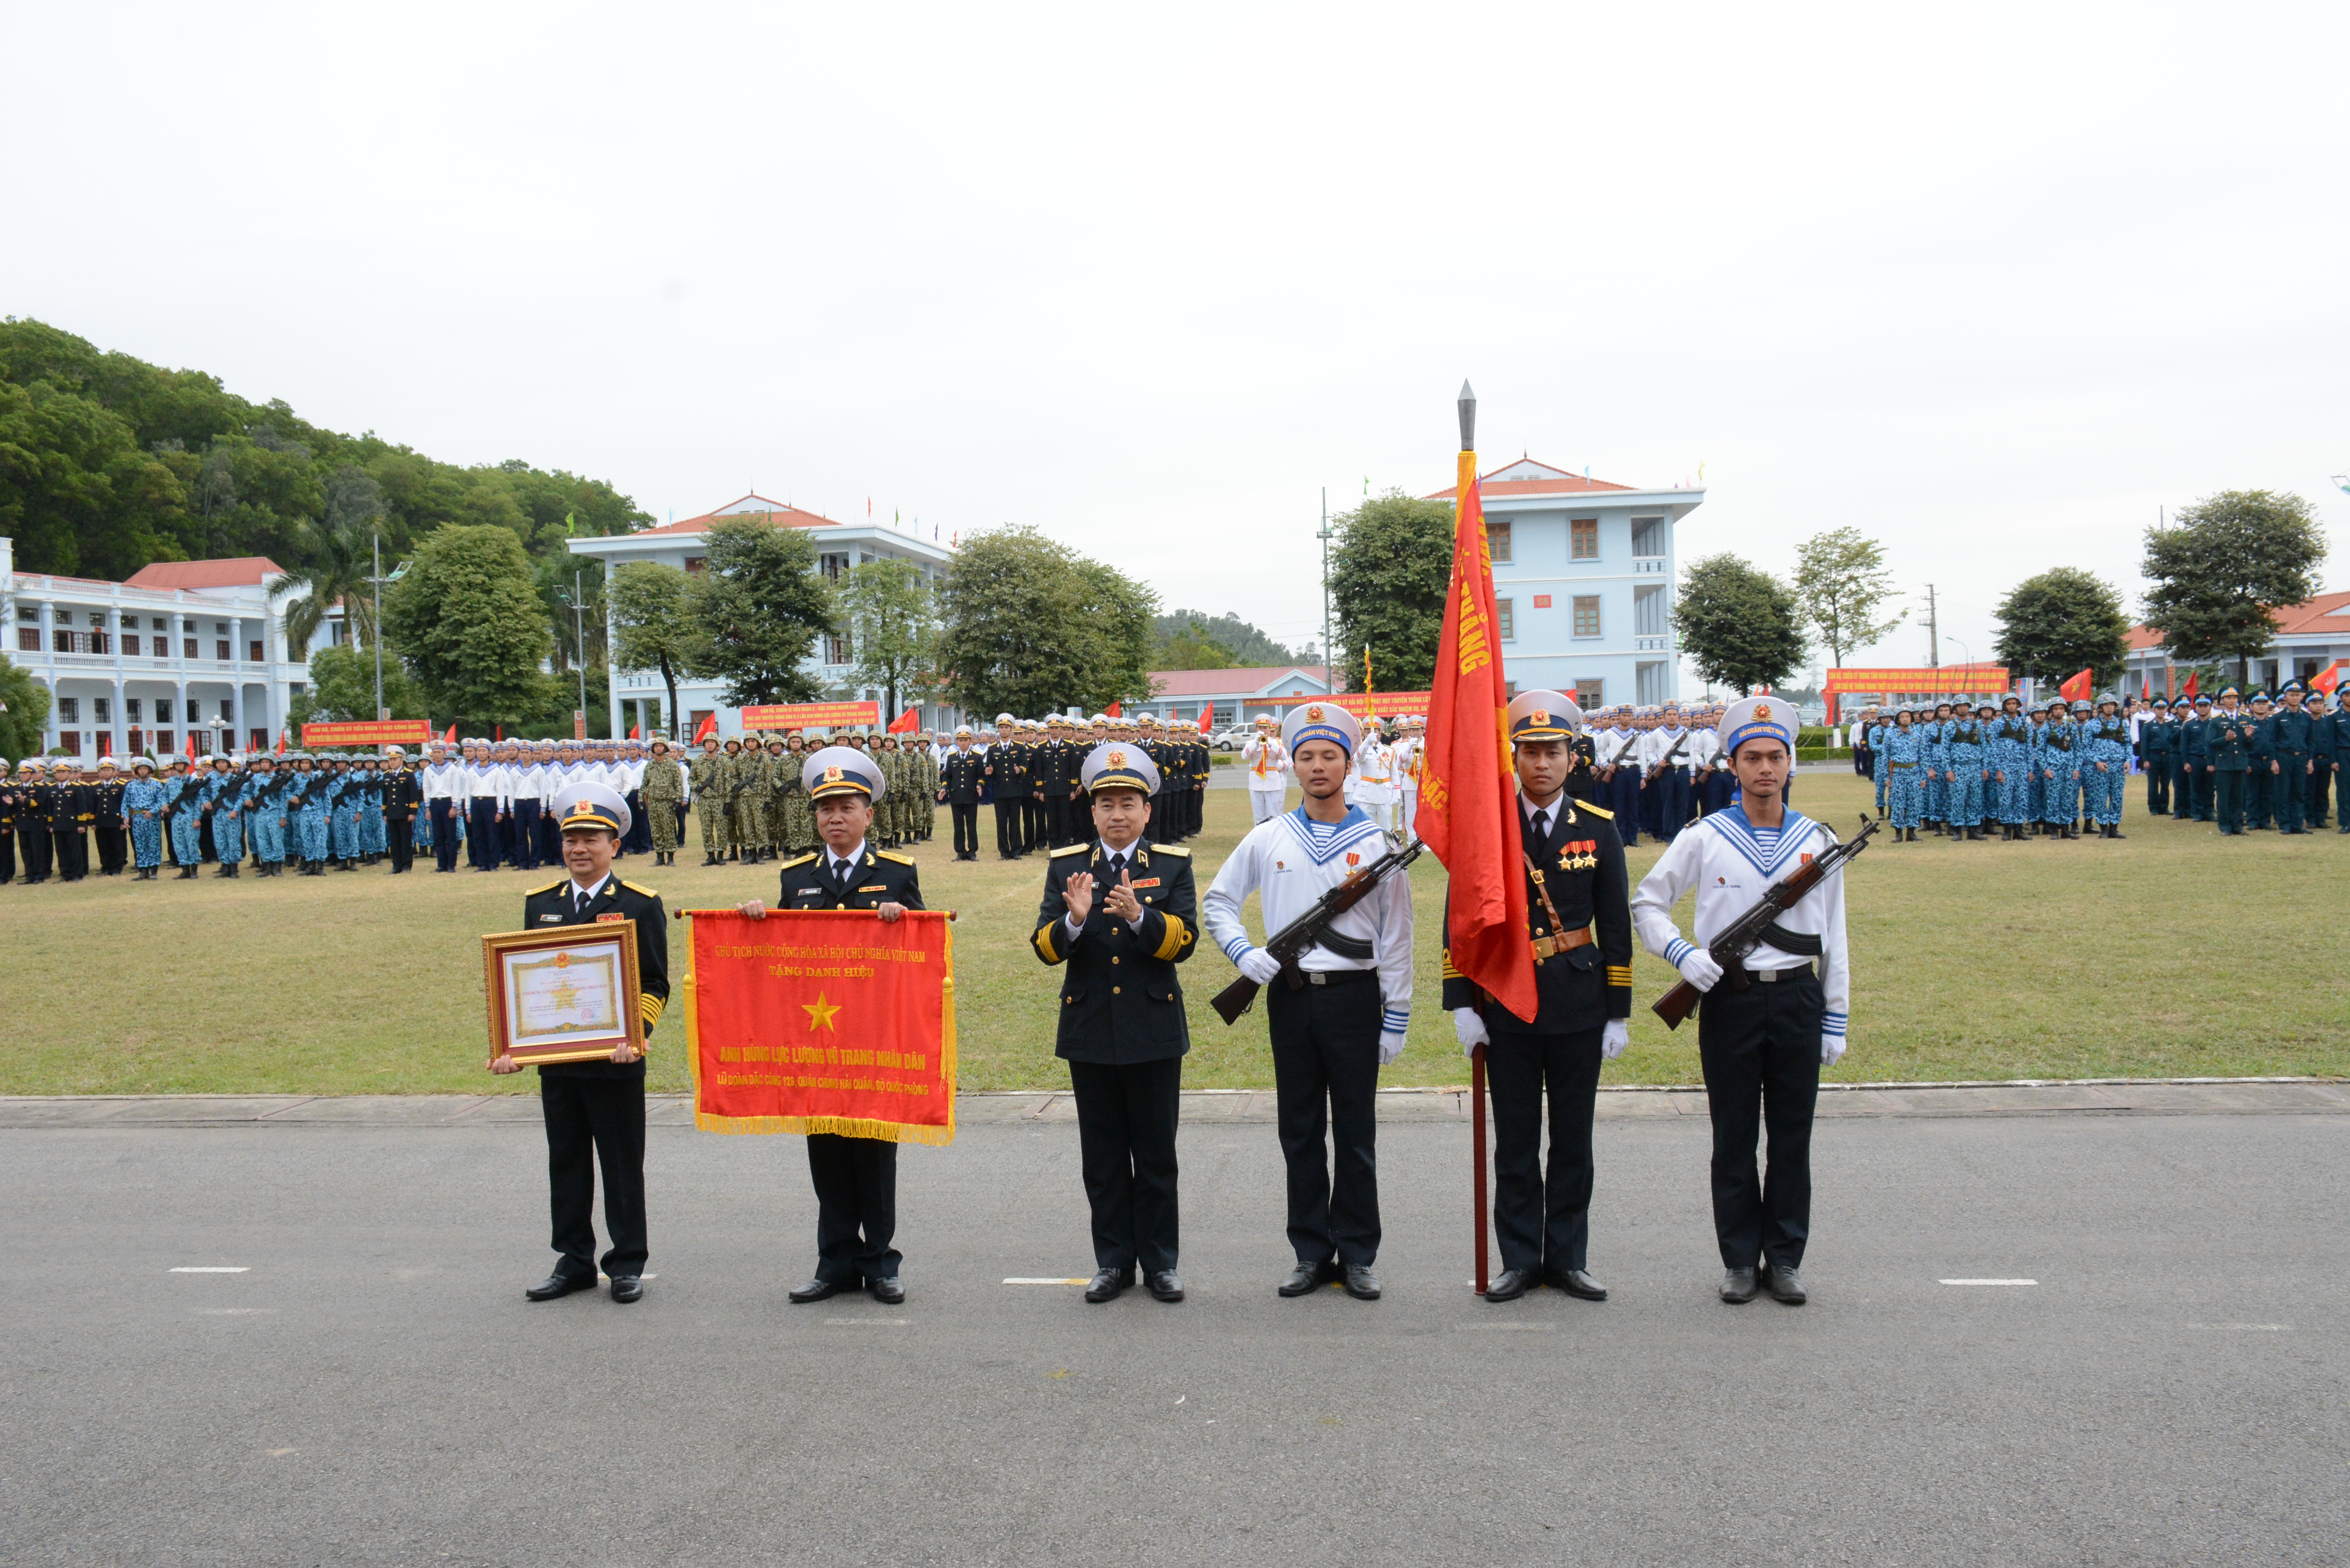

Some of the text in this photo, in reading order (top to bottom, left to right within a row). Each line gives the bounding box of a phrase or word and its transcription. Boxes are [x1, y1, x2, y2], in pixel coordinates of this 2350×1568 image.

[1537, 597, 1549, 606] S8
[1302, 729, 1316, 738] QUÂN
[1316, 728, 1329, 736] VIỆT
[1329, 731, 1340, 740] NAM
[1747, 725, 1762, 734] QUÂN
[1762, 725, 1775, 734] VIỆT
[1775, 729, 1785, 737] NAM
[1422, 770, 1448, 810] ĐẶC
[715, 942, 926, 964] CHỦ TỊCH NƯỚC CỘNG HÒA XÃ HỘI CHỦ NGHĨA VIỆT NAM
[768, 964, 875, 979] TẶNG DANH HIỆU
[720, 1043, 926, 1070] ANH HÙNG LỰC LƯỢNG VŨ TRANG NHÂN DÂN
[717, 1071, 727, 1085] LỮ
[728, 1072, 748, 1086] ĐOÀN
[748, 1071, 764, 1088] ĐẶC
[765, 1072, 781, 1086] CÔNG
[798, 1073, 816, 1088] QUÂN
[817, 1073, 838, 1089] CHỦNG
[839, 1074, 852, 1090] HẢI
[853, 1076, 875, 1091] QUÂN,
[876, 1078, 885, 1094] BỘ
[886, 1077, 903, 1094] QUỐC
[904, 1081, 929, 1096] PHÒNG
